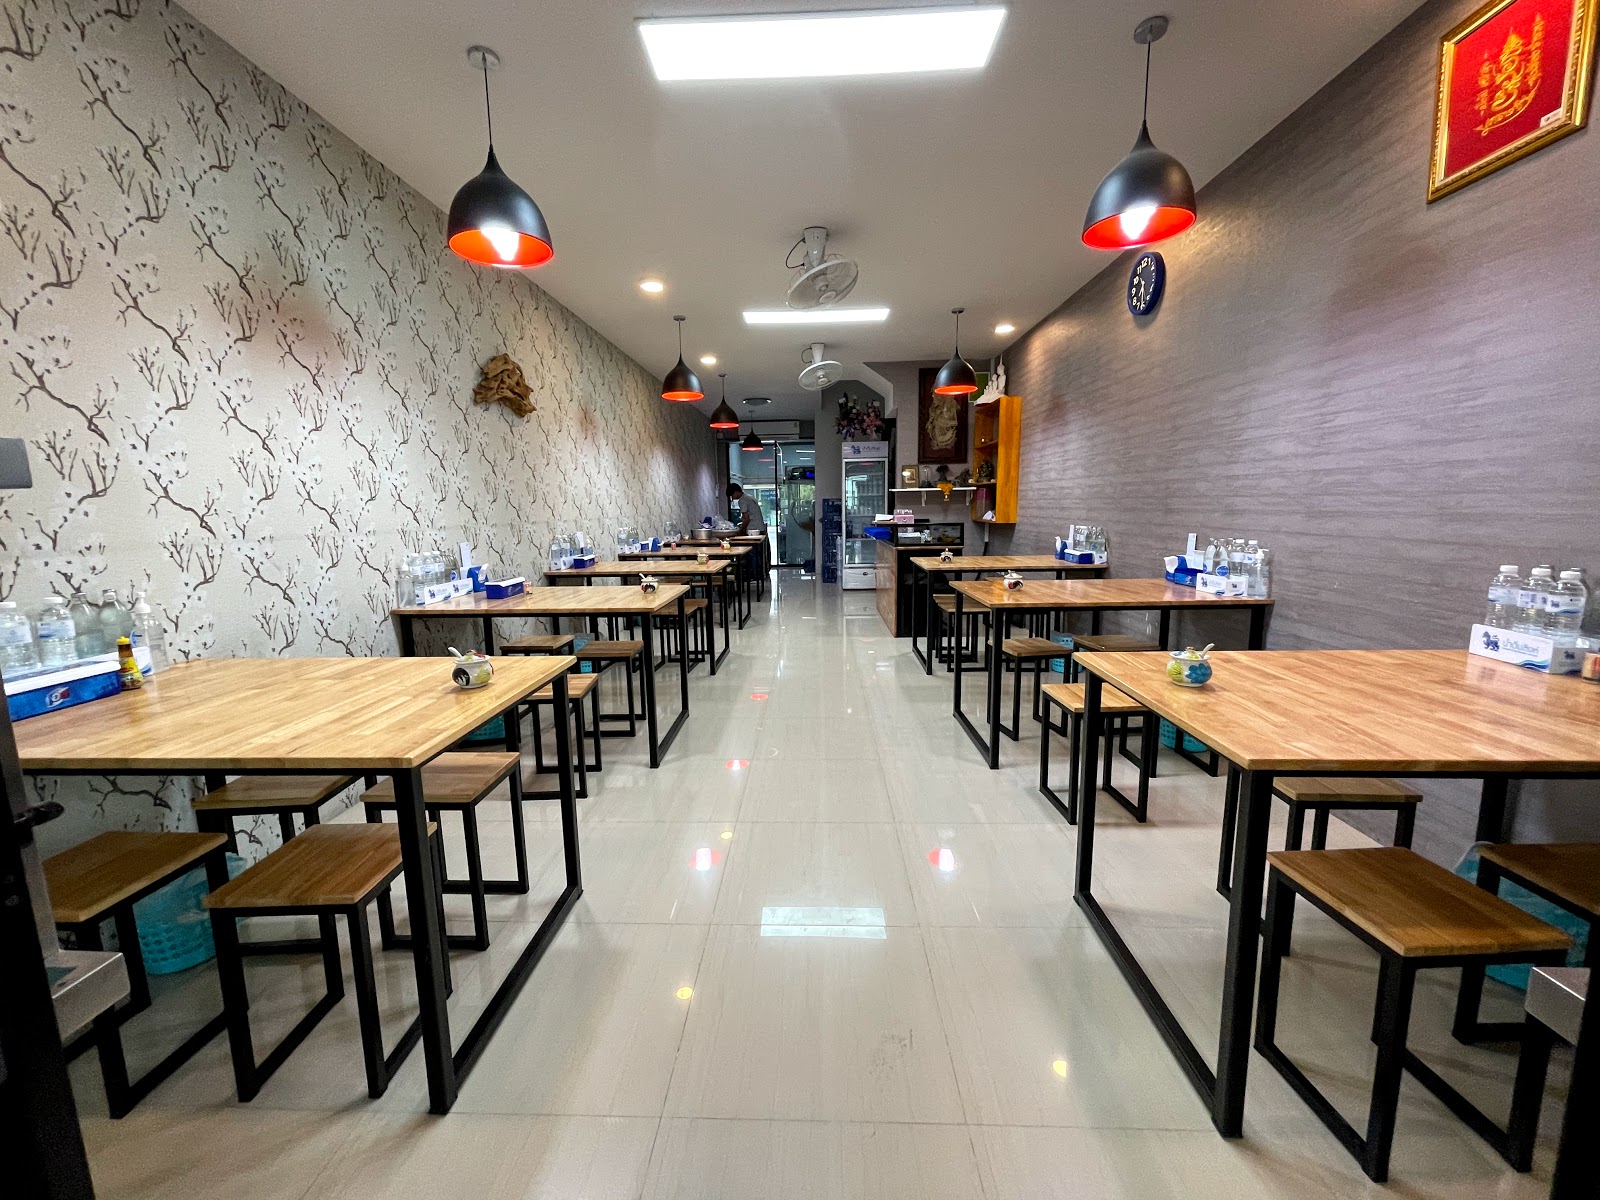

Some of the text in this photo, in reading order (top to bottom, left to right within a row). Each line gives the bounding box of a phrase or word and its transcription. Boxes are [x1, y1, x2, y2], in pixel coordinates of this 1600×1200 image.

[1141, 257, 1148, 268] 12
[1137, 265, 1142, 275] 11
[1133, 276, 1139, 285] 10
[1132, 287, 1136, 297] 9
[1132, 297, 1137, 305] 8
[1136, 301, 1140, 311] 7
